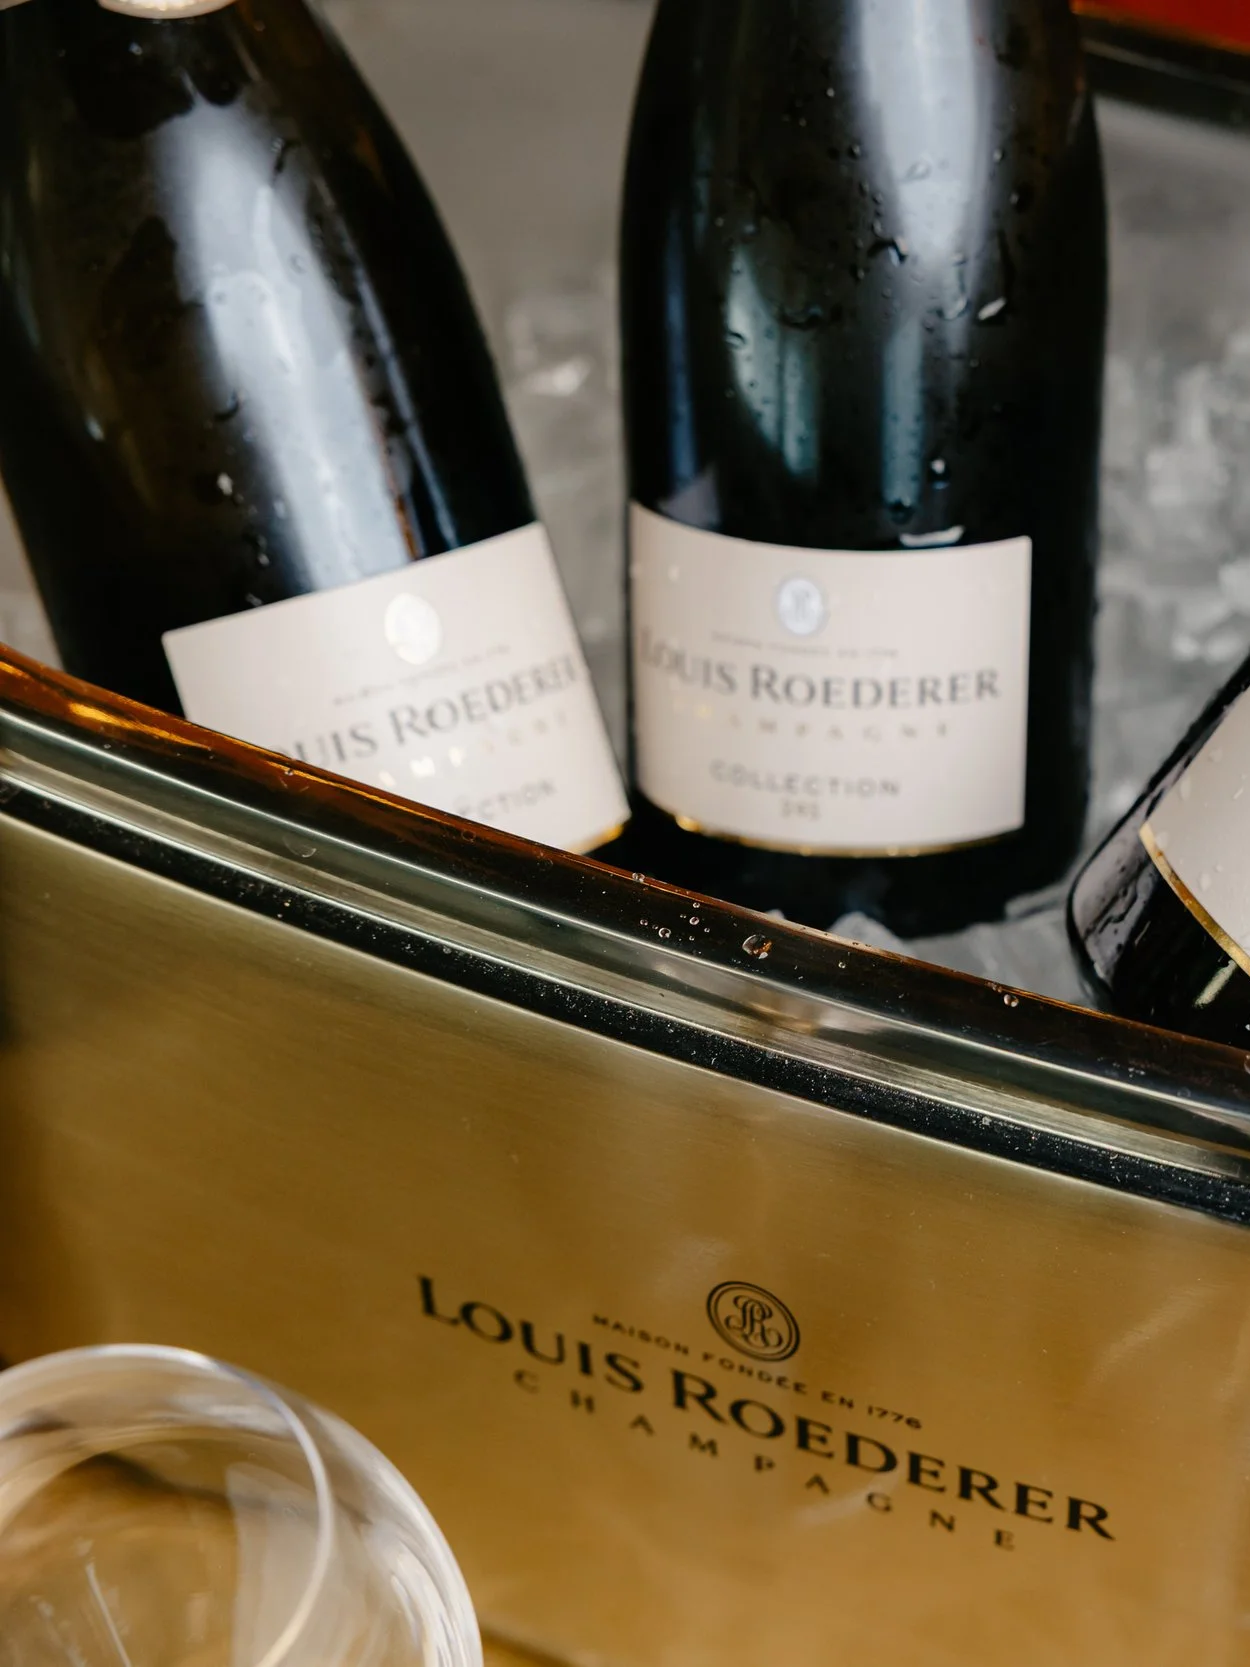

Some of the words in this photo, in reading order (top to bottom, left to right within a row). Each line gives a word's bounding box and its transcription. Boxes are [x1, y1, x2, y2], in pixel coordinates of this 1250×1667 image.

[749, 662, 1002, 710] ROEDERER
[270, 721, 380, 767] UIS
[708, 758, 901, 799] COLLECTION
[417, 1273, 645, 1393] LOUIS
[670, 1368, 1116, 1541] ROEDERER
[593, 1313, 690, 1356] MAISON
[701, 1351, 807, 1394] FONDÉE
[820, 1390, 855, 1410] EN
[866, 1405, 923, 1430] 1776
[513, 1368, 1016, 1551] CHAMPAGNE
